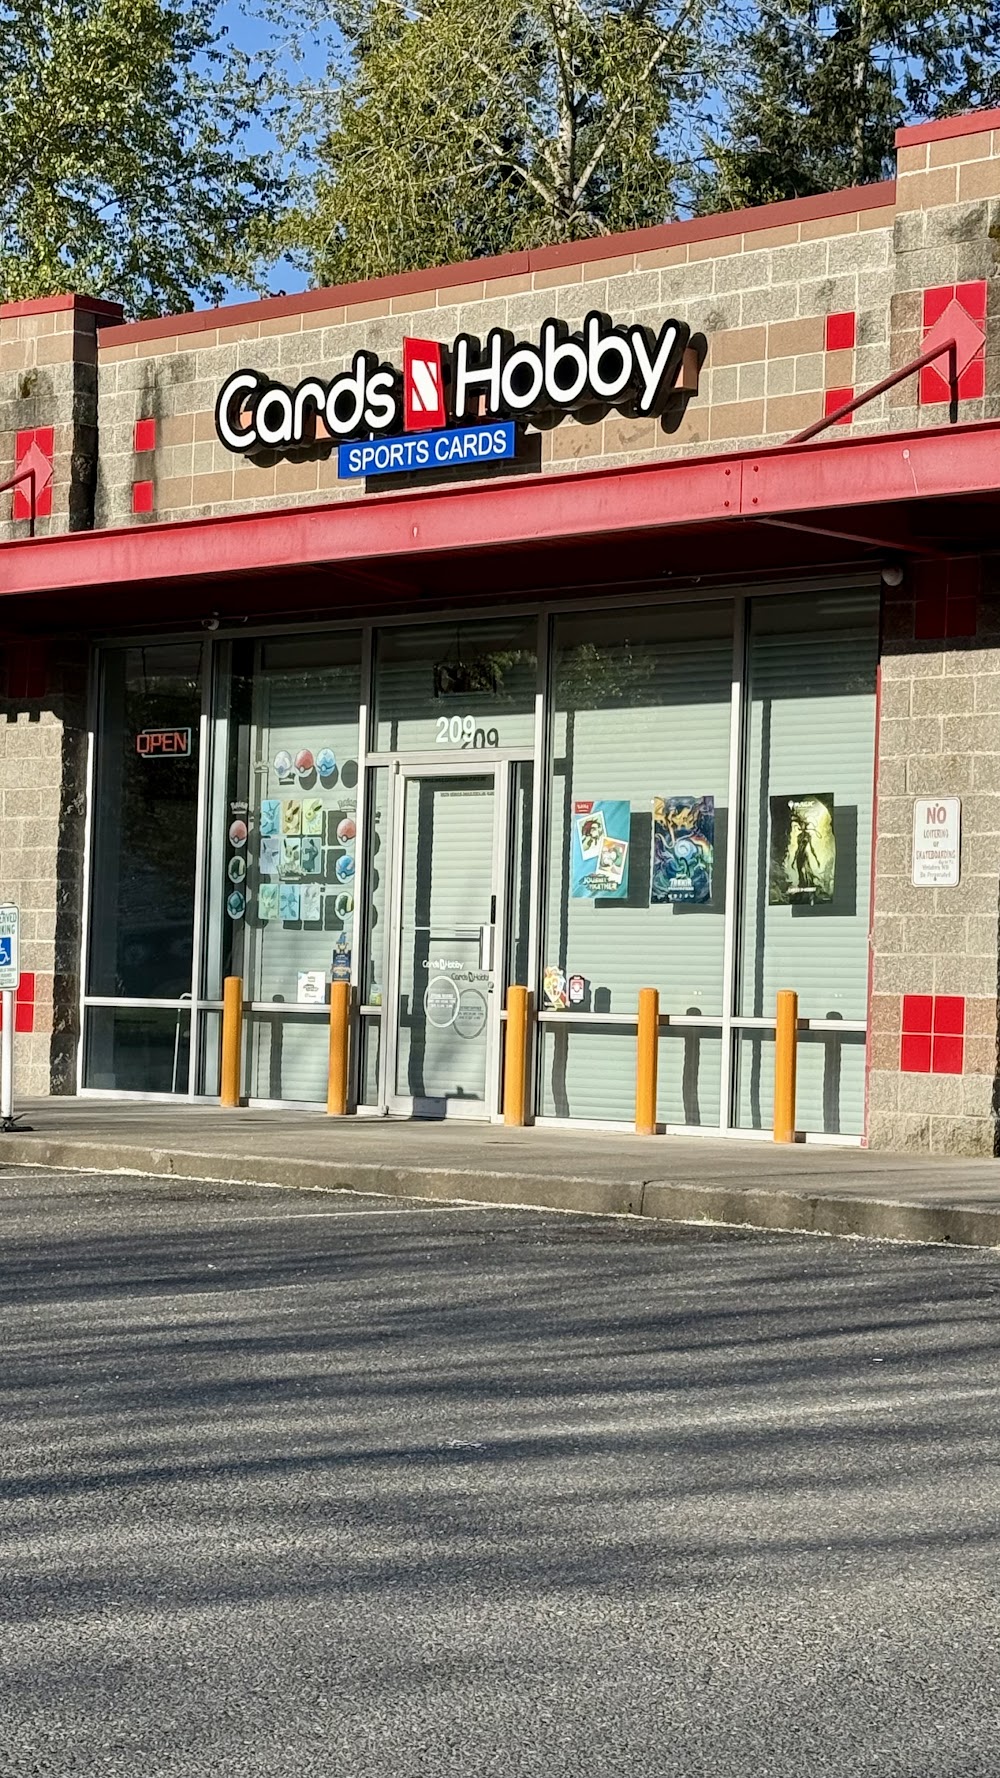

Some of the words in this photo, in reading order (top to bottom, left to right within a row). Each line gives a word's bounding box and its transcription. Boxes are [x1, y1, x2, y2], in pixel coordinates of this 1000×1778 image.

[217, 355, 397, 449] Cards
[454, 316, 679, 418] Hobby
[348, 440, 430, 472] SPORTS
[435, 430, 507, 461] CARDS
[136, 732, 187, 753] OPEN
[435, 714, 476, 743] 209
[926, 806, 947, 825] NO
